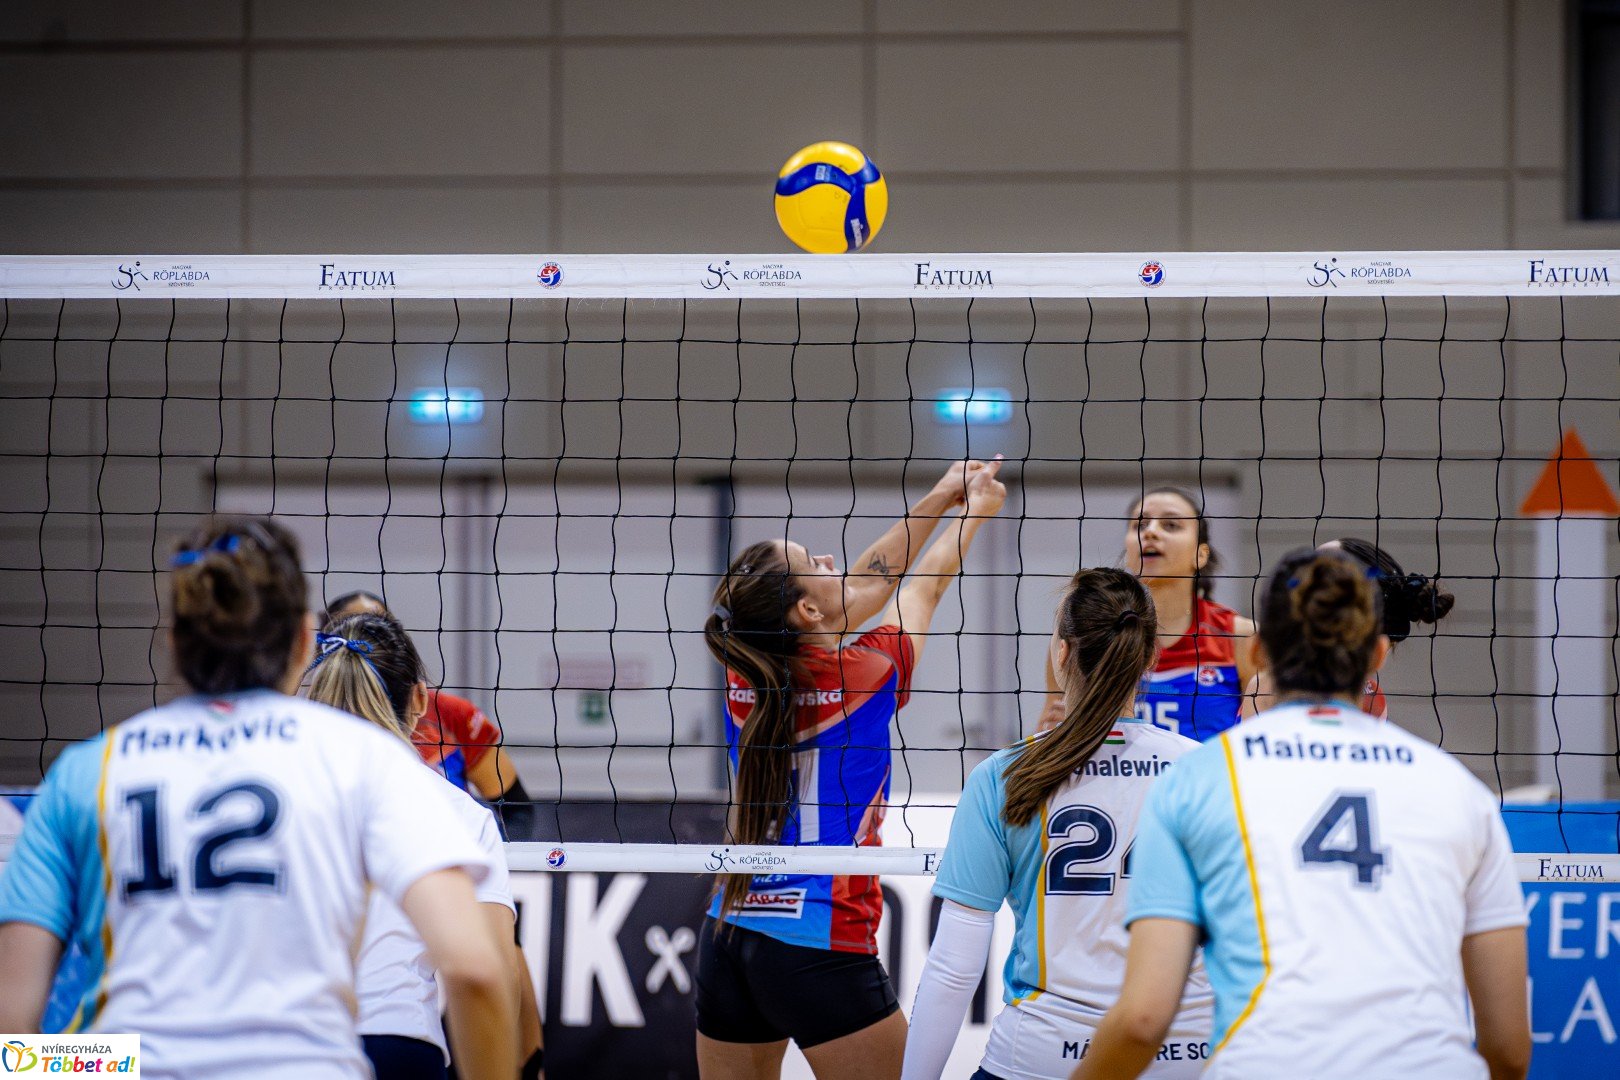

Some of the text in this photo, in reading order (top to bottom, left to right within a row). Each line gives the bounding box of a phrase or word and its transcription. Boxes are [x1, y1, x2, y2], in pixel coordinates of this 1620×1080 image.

[153, 270, 210, 281] RÖPLABDA
[743, 269, 802, 280] RÖPLABDA
[1351, 266, 1412, 278] RÖPLABDA
[1244, 734, 1413, 766] Maiorano
[121, 782, 288, 895] 12
[1298, 789, 1391, 892] 4
[739, 855, 787, 865] RÖPLABDA
[1045, 805, 1134, 896] 2
